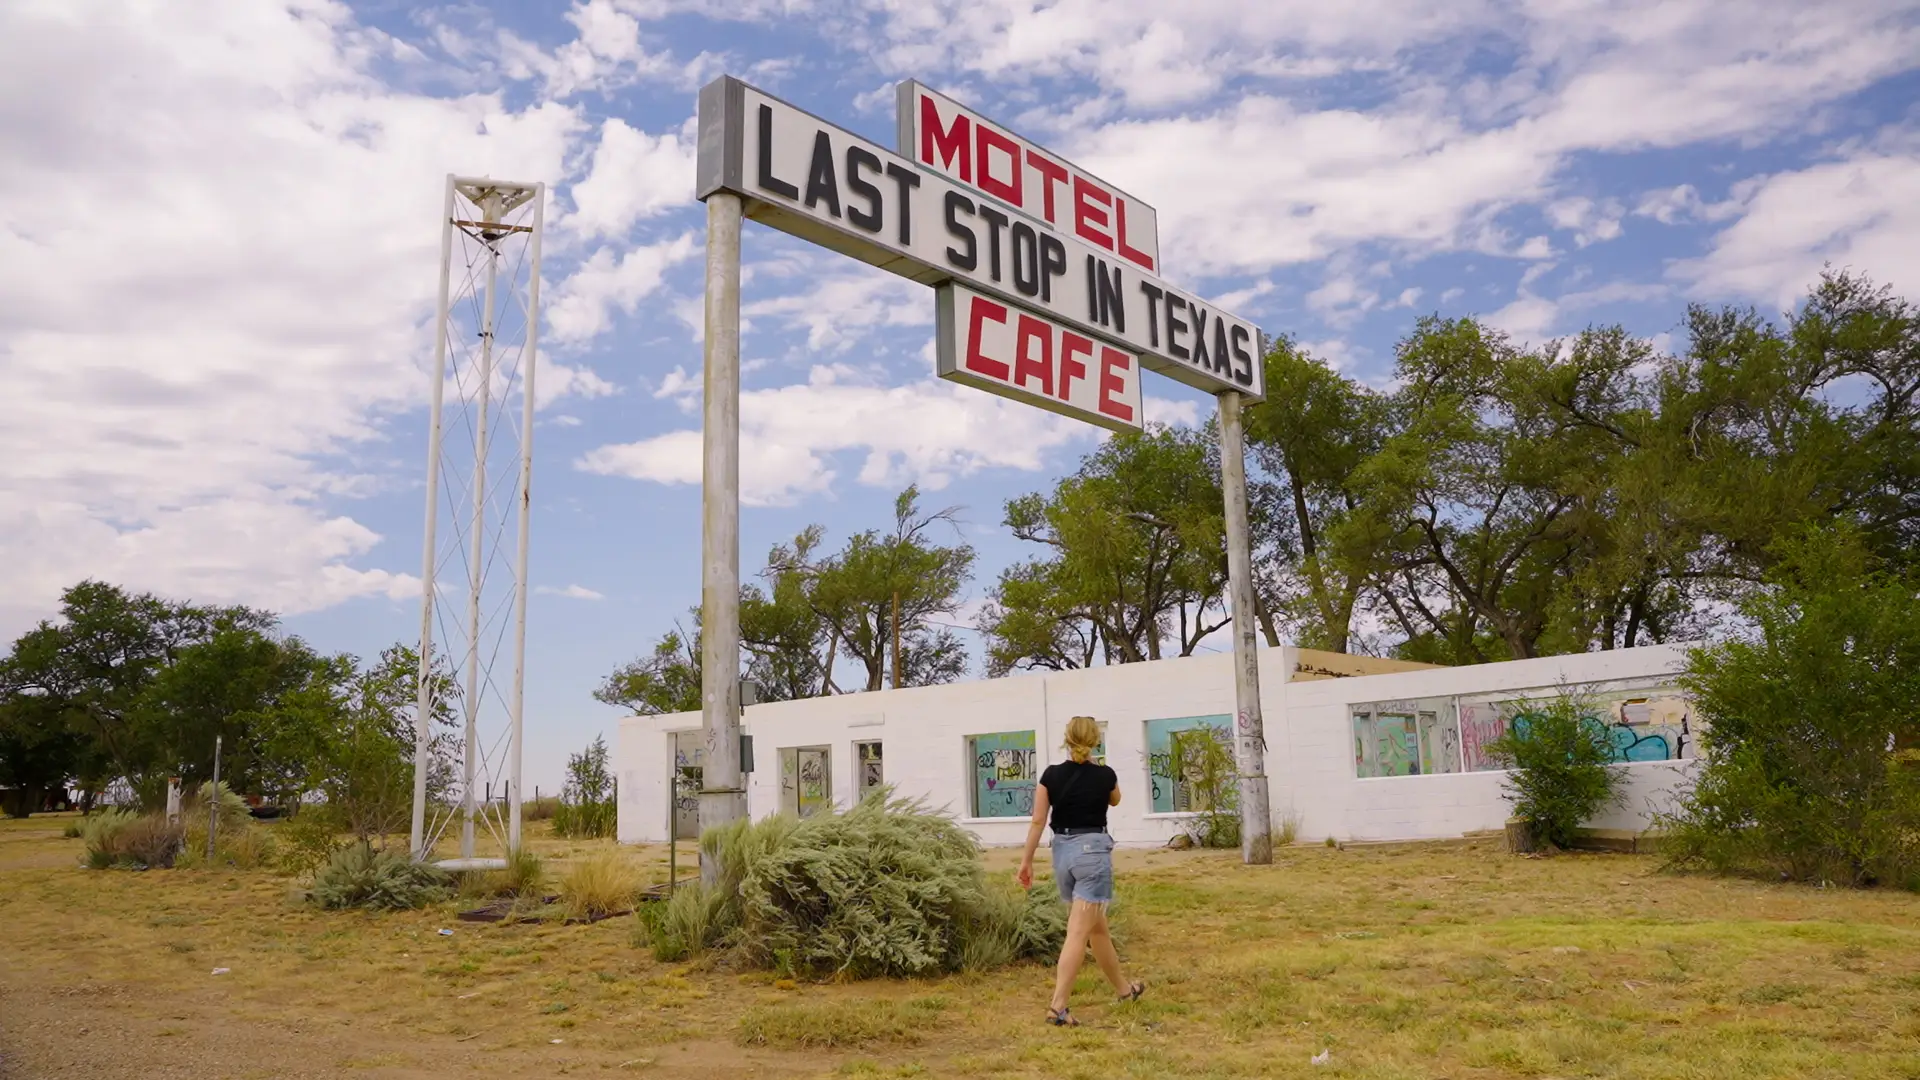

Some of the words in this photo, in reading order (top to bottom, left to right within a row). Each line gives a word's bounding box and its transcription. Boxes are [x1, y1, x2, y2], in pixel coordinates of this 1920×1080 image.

[758, 103, 921, 246] LAST
[944, 190, 1067, 303] STOP
[1087, 253, 1125, 334] IN
[1140, 280, 1253, 387] TEXAS
[920, 95, 1153, 270] MOTEL
[966, 296, 1133, 421] CAFE
